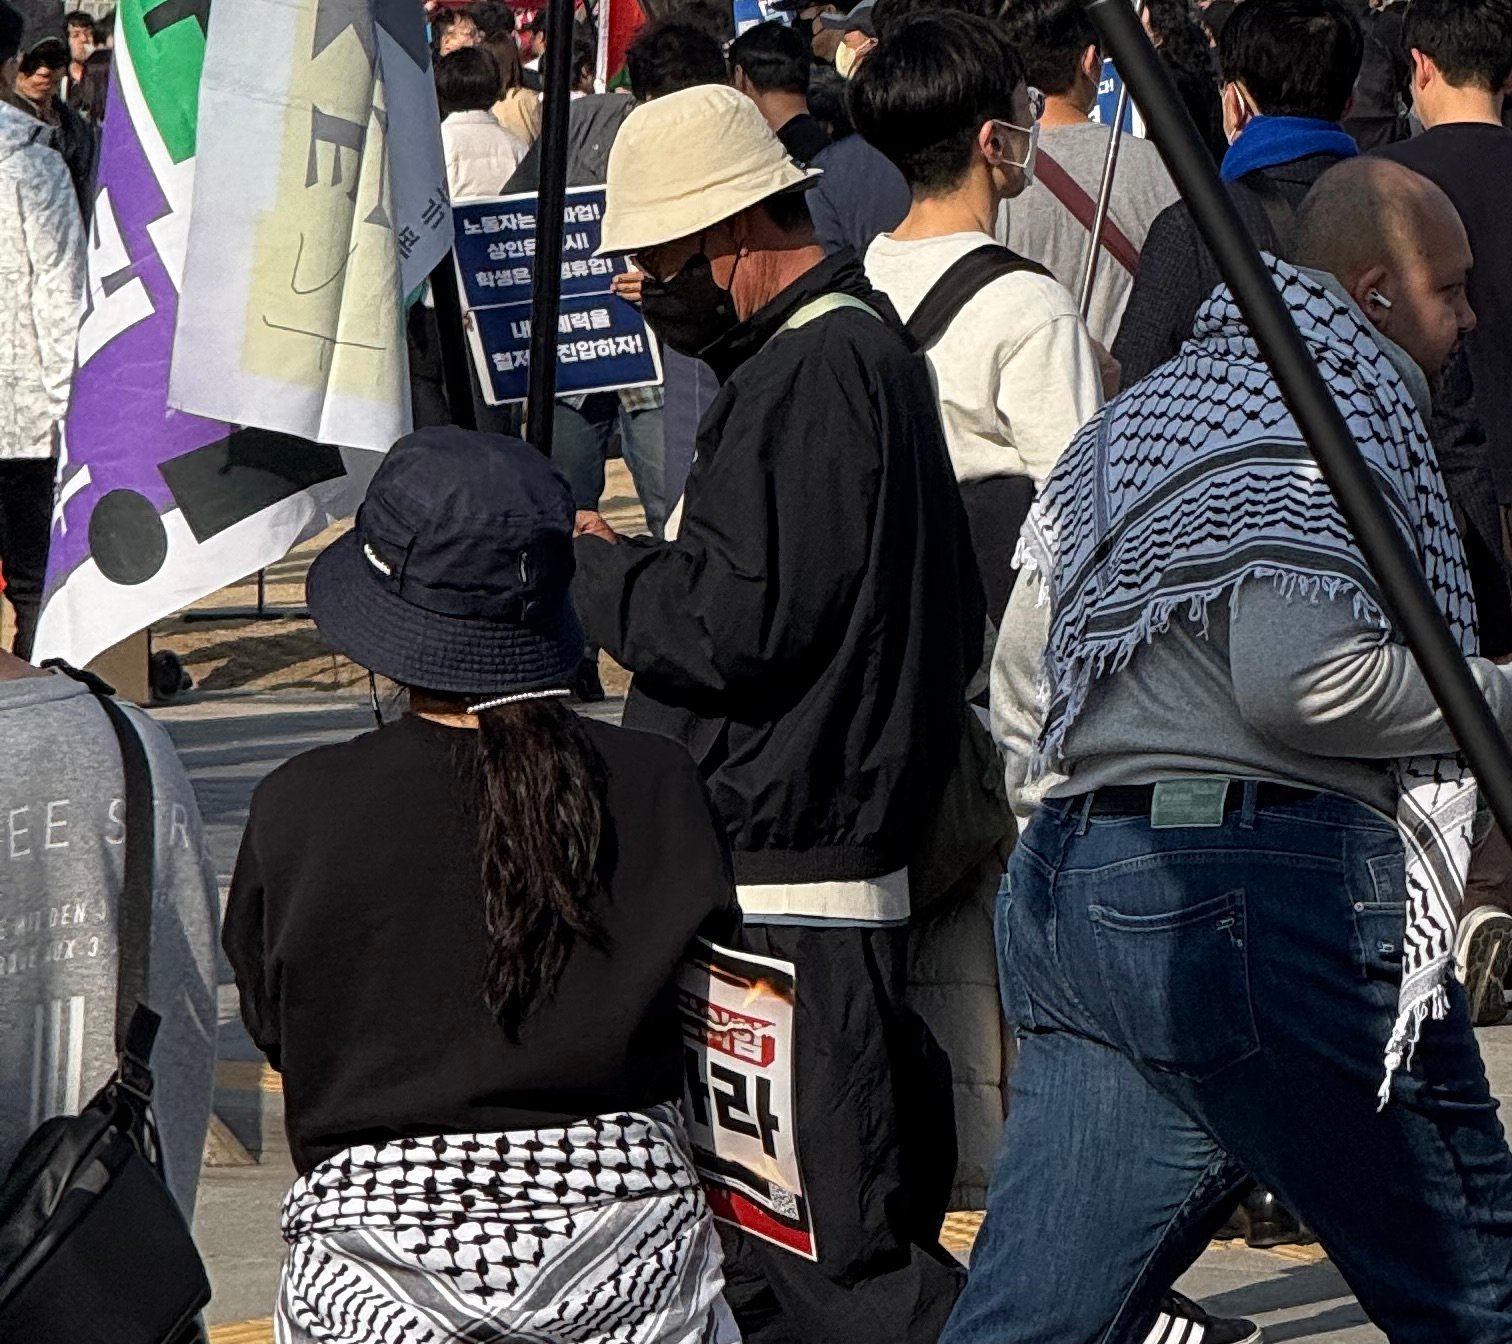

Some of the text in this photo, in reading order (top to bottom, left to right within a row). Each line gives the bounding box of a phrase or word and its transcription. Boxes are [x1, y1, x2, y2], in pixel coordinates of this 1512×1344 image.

[475, 267, 533, 288] 학생은
[510, 308, 612, 339] 내세력을
[556, 334, 644, 364] 진압하자!
[8, 798, 70, 858] EE
